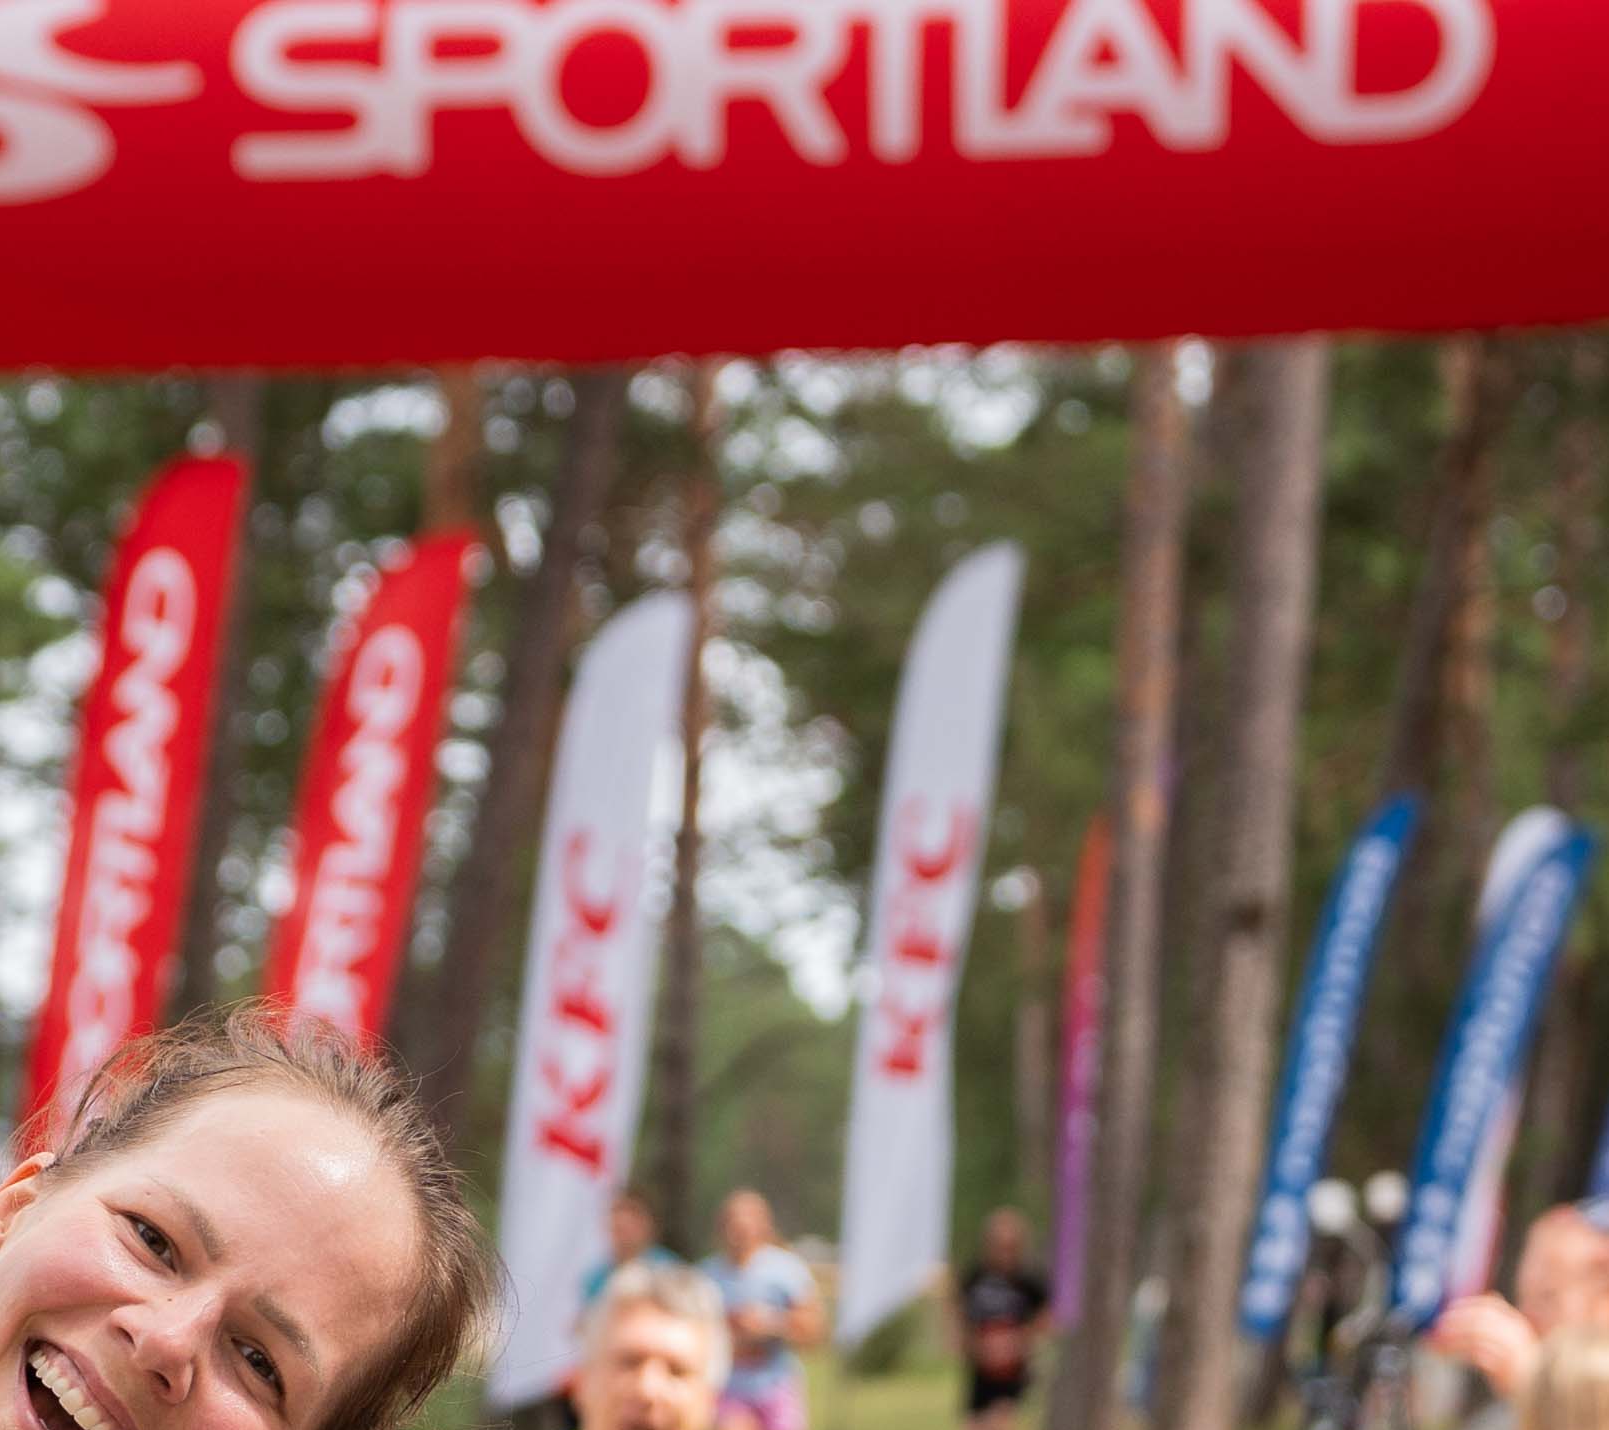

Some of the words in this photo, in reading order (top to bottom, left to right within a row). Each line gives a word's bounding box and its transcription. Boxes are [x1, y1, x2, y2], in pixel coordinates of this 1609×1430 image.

[228, 0, 1497, 181] SPORTLAND
[58, 545, 198, 1105] ORTLAND
[295, 622, 426, 1060] RTLAND
[533, 826, 645, 1176] KFC
